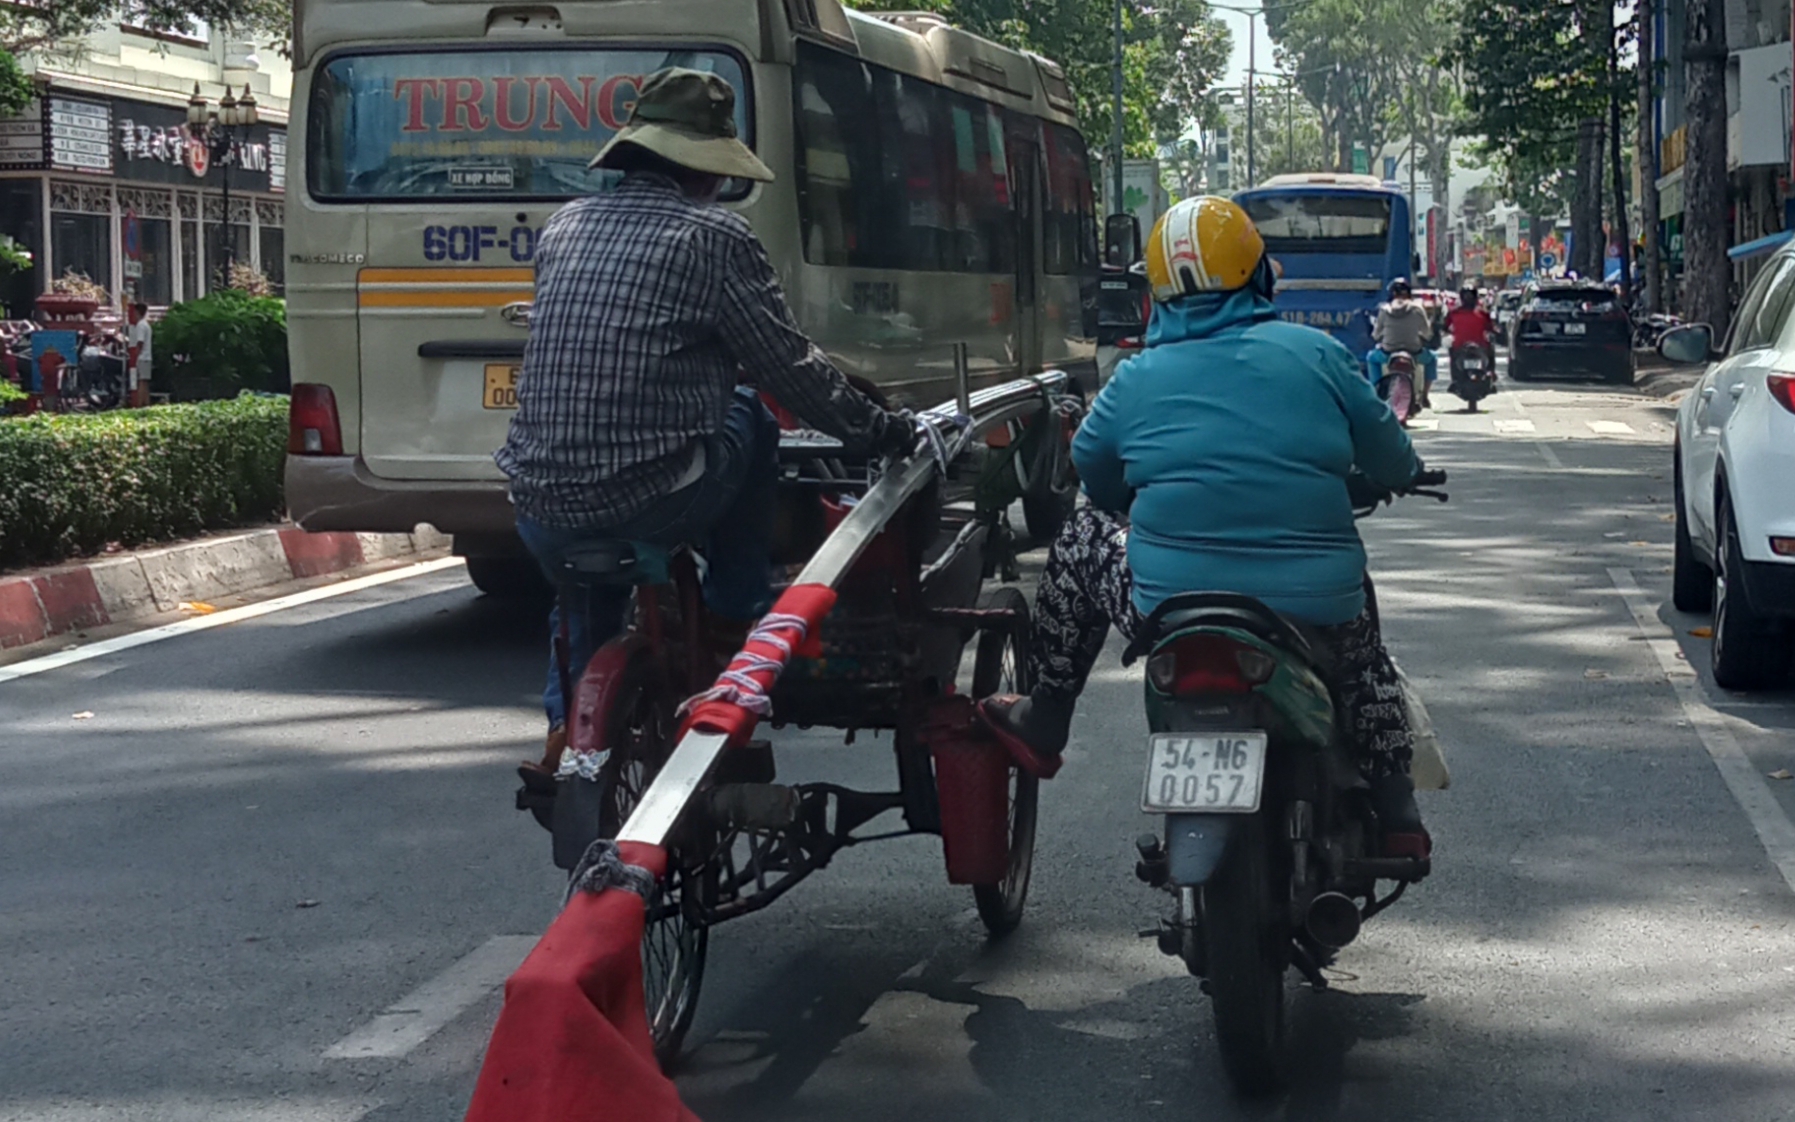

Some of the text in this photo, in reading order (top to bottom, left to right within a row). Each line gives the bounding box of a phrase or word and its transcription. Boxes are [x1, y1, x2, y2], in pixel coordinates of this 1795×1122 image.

[394, 74, 645, 132] TRUNG
[1160, 739, 1248, 770] 54-N6
[1159, 774, 1244, 805] 0057
